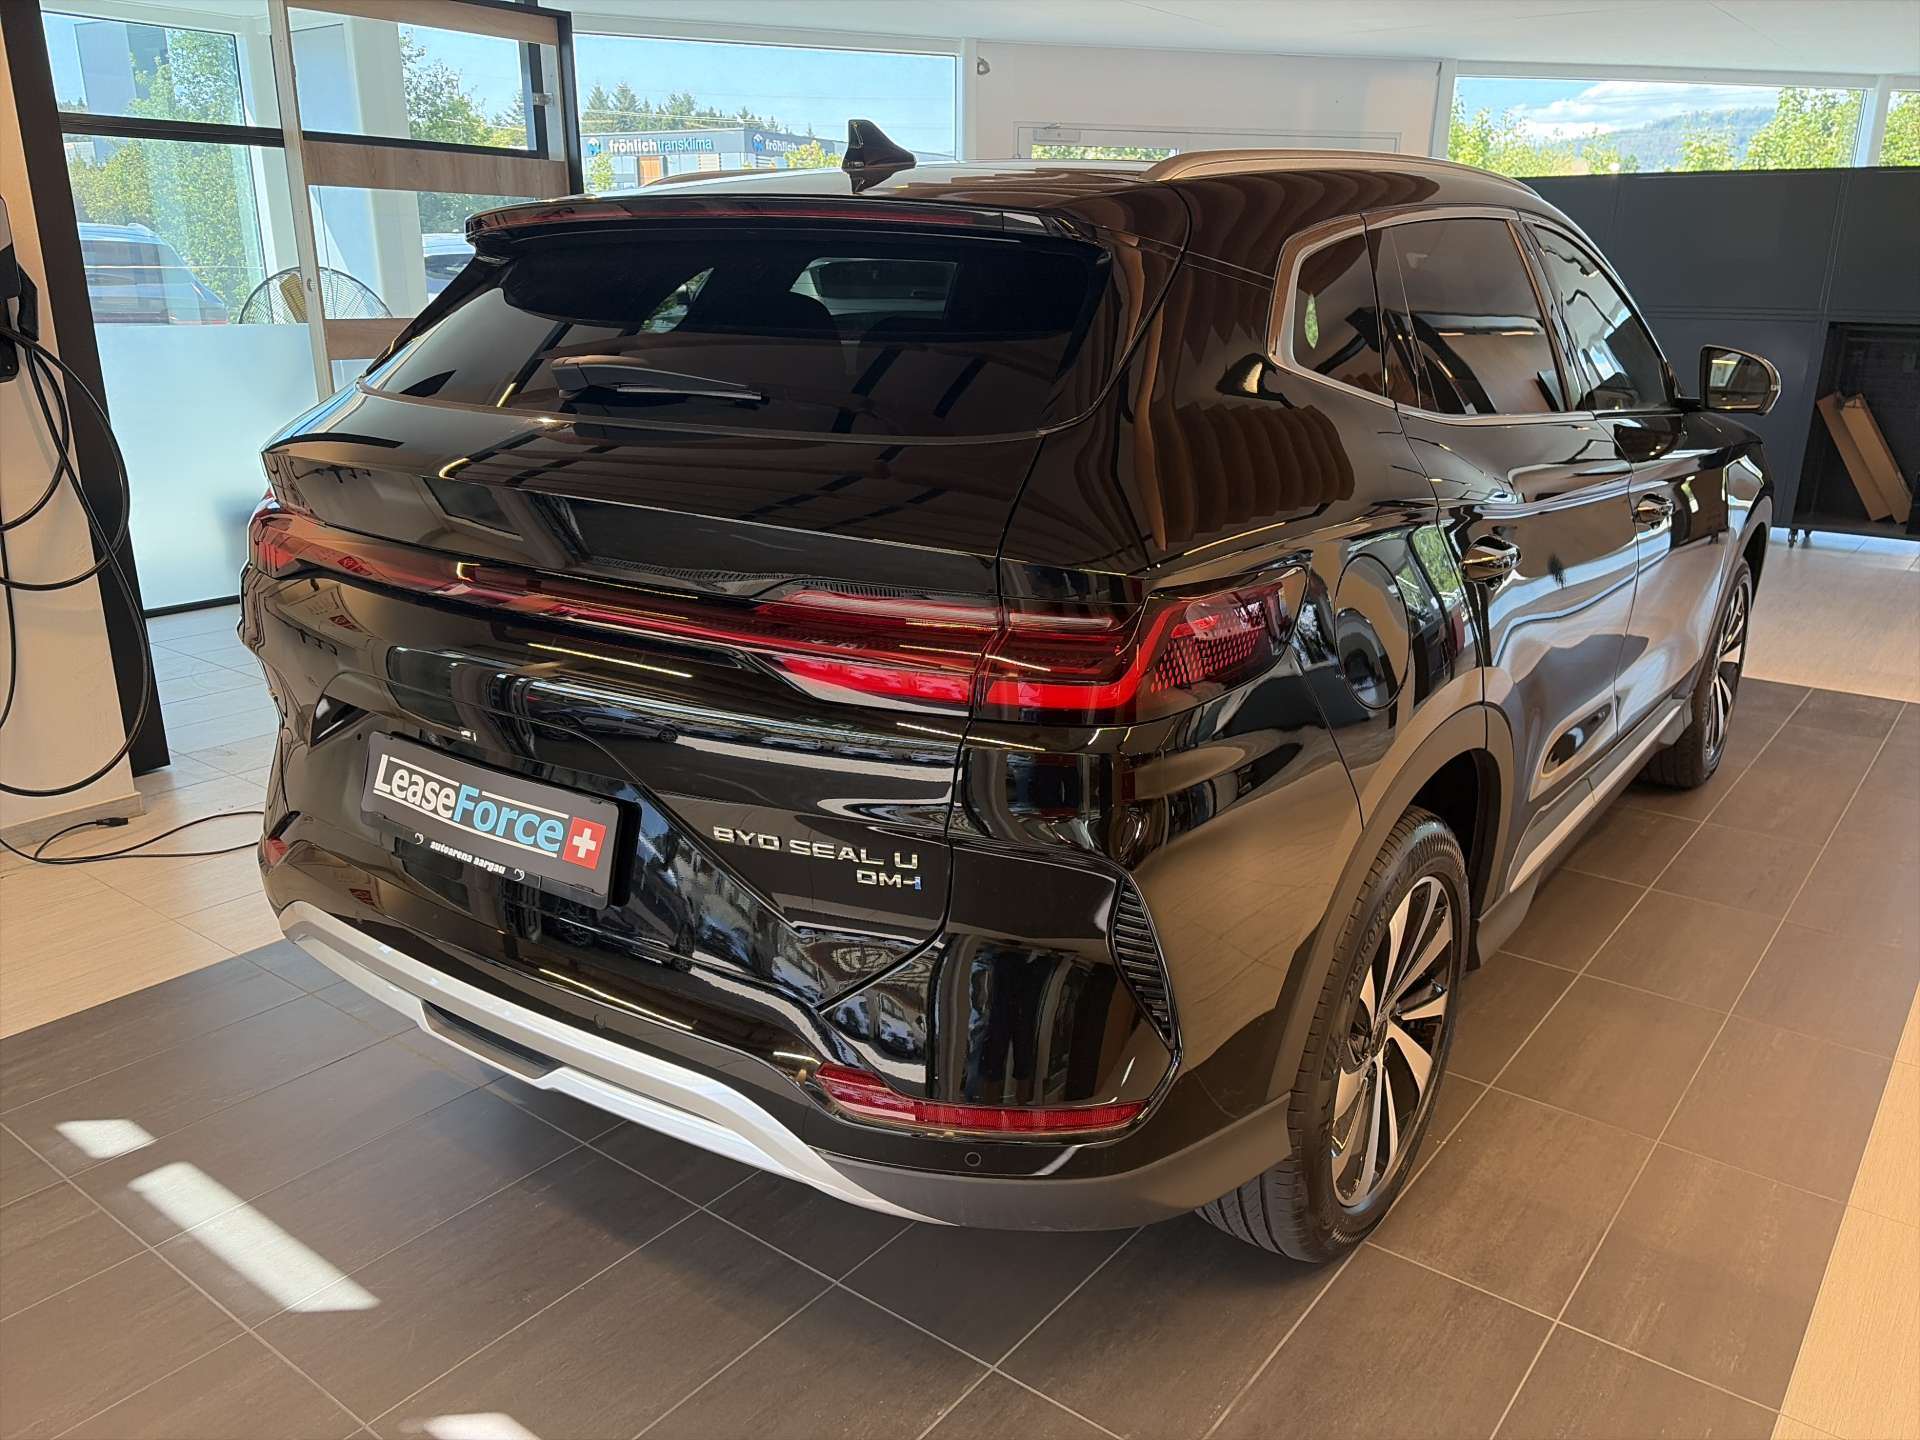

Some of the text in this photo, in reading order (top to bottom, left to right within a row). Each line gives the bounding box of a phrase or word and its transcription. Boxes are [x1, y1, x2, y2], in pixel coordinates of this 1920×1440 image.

[373, 754, 564, 852] LeaseForce
[430, 841, 506, 875] autoarena aargau
[713, 826, 918, 869] BYD SEAL U
